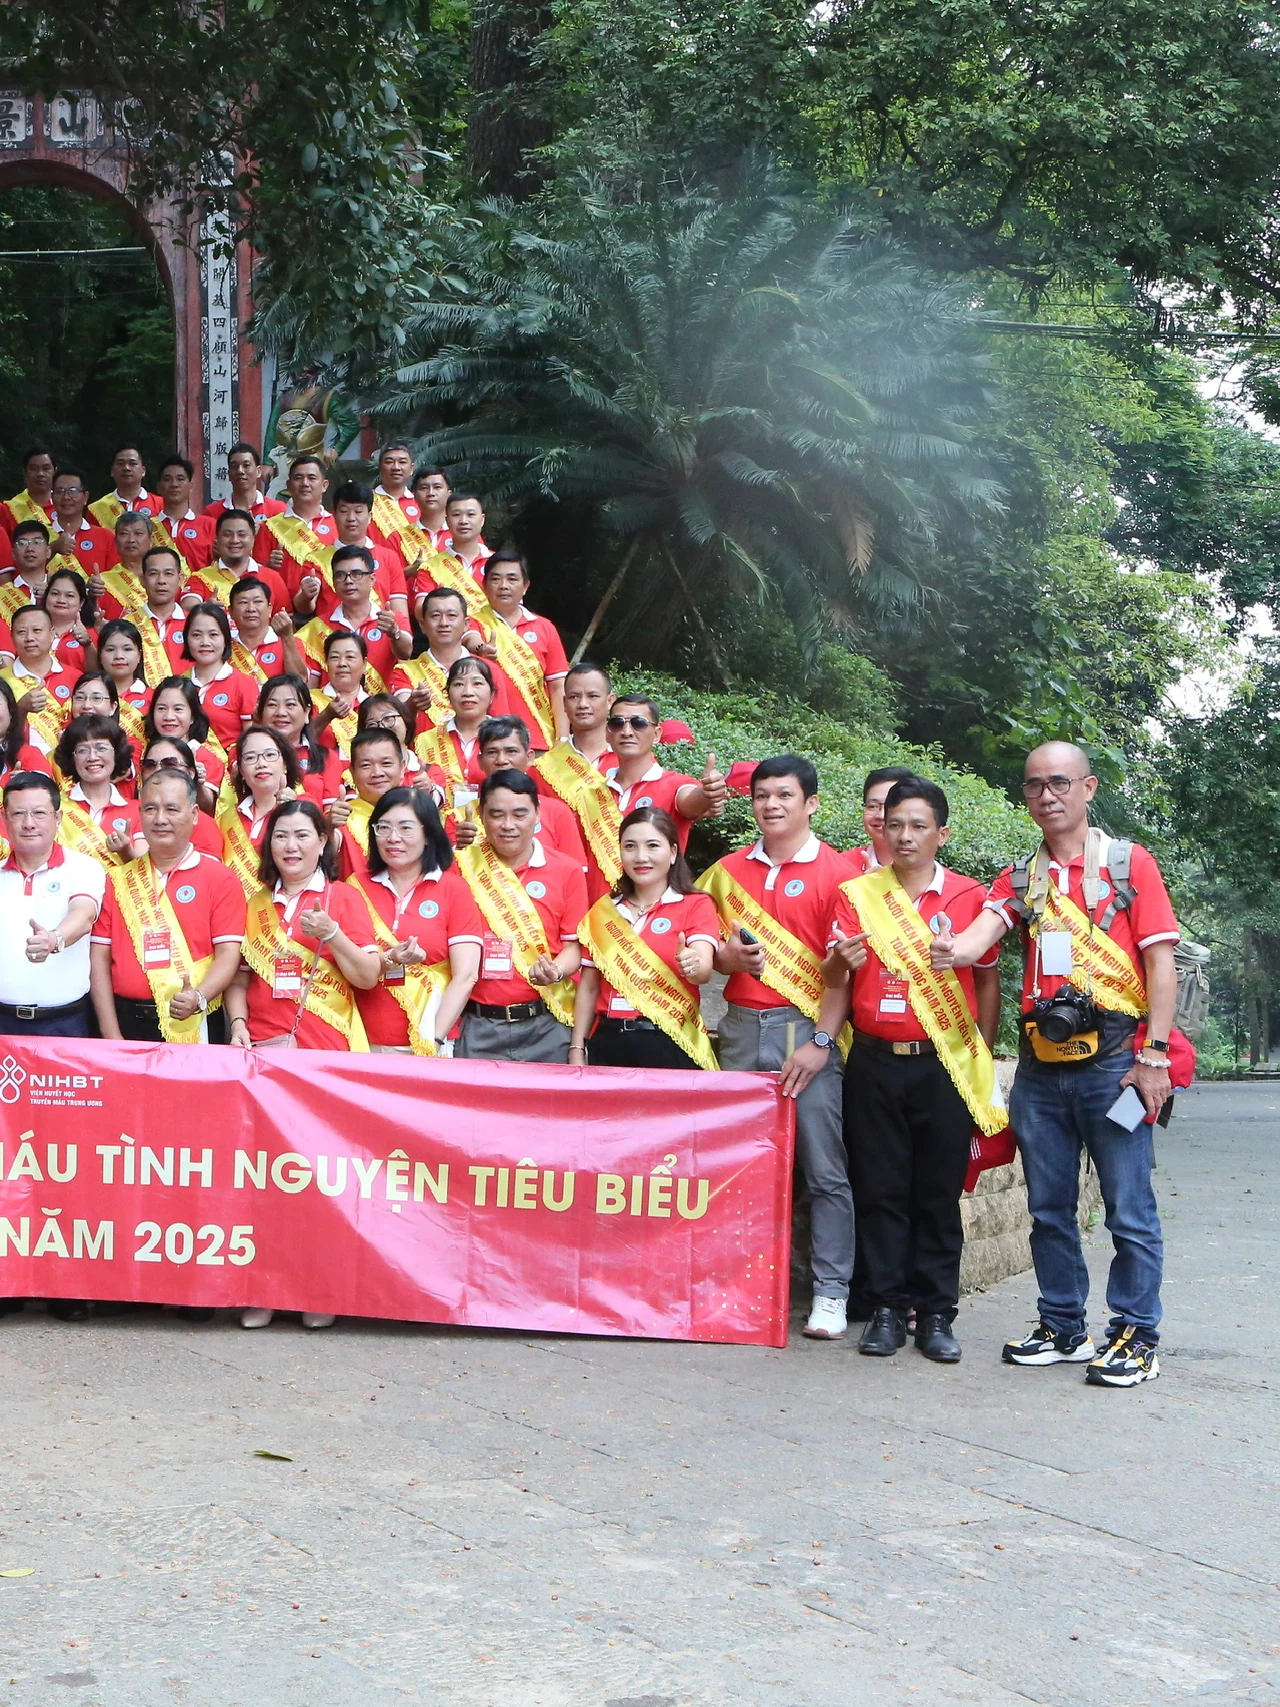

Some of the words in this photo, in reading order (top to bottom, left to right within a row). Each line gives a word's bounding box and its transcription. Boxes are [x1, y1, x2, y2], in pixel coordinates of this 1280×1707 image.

[564, 754, 586, 775] NGƯỜI
[476, 869, 494, 890] TOÀN
[488, 889, 509, 912] QUỐC
[501, 910, 519, 931] NĂM
[512, 931, 529, 952] 2025
[881, 889, 907, 919] NGƯỜI
[724, 891, 747, 915] NGƯỜI
[740, 909, 765, 930] HIẾN
[757, 924, 780, 945] MÁU
[774, 939, 797, 960] TÌNH
[896, 916, 920, 940] HIẾN
[910, 938, 933, 962] MÁU
[1098, 950, 1137, 985] NGUYỆN
[612, 952, 633, 976] TOÀN
[627, 971, 653, 995] QUỐC
[649, 989, 673, 1010] NĂM
[667, 1005, 689, 1027] 2025
[617, 935, 637, 954] HIẾN
[631, 950, 652, 971] MÁU
[646, 967, 667, 989] TÌNH
[662, 984, 695, 1015] NGUYỆN
[777, 964, 802, 985] NĂM
[798, 980, 821, 1001] 2025
[889, 936, 912, 961] TOÀN
[904, 960, 929, 987] QUỐC
[919, 984, 942, 1009] NĂM
[932, 1007, 951, 1031] 2025
[1102, 974, 1127, 994] 2025
[938, 981, 965, 1020] NGUYỆN
[956, 1016, 973, 1038] TIÊU
[963, 1036, 982, 1058] BIỂU
[30, 1074, 104, 1089] NIHBT
[96, 1134, 212, 1188] TÌNH
[234, 1150, 448, 1214] NGUYỆN
[469, 1154, 575, 1212] TIÊU
[596, 1154, 712, 1220] BIỂU
[134, 1222, 255, 1265] 2025
